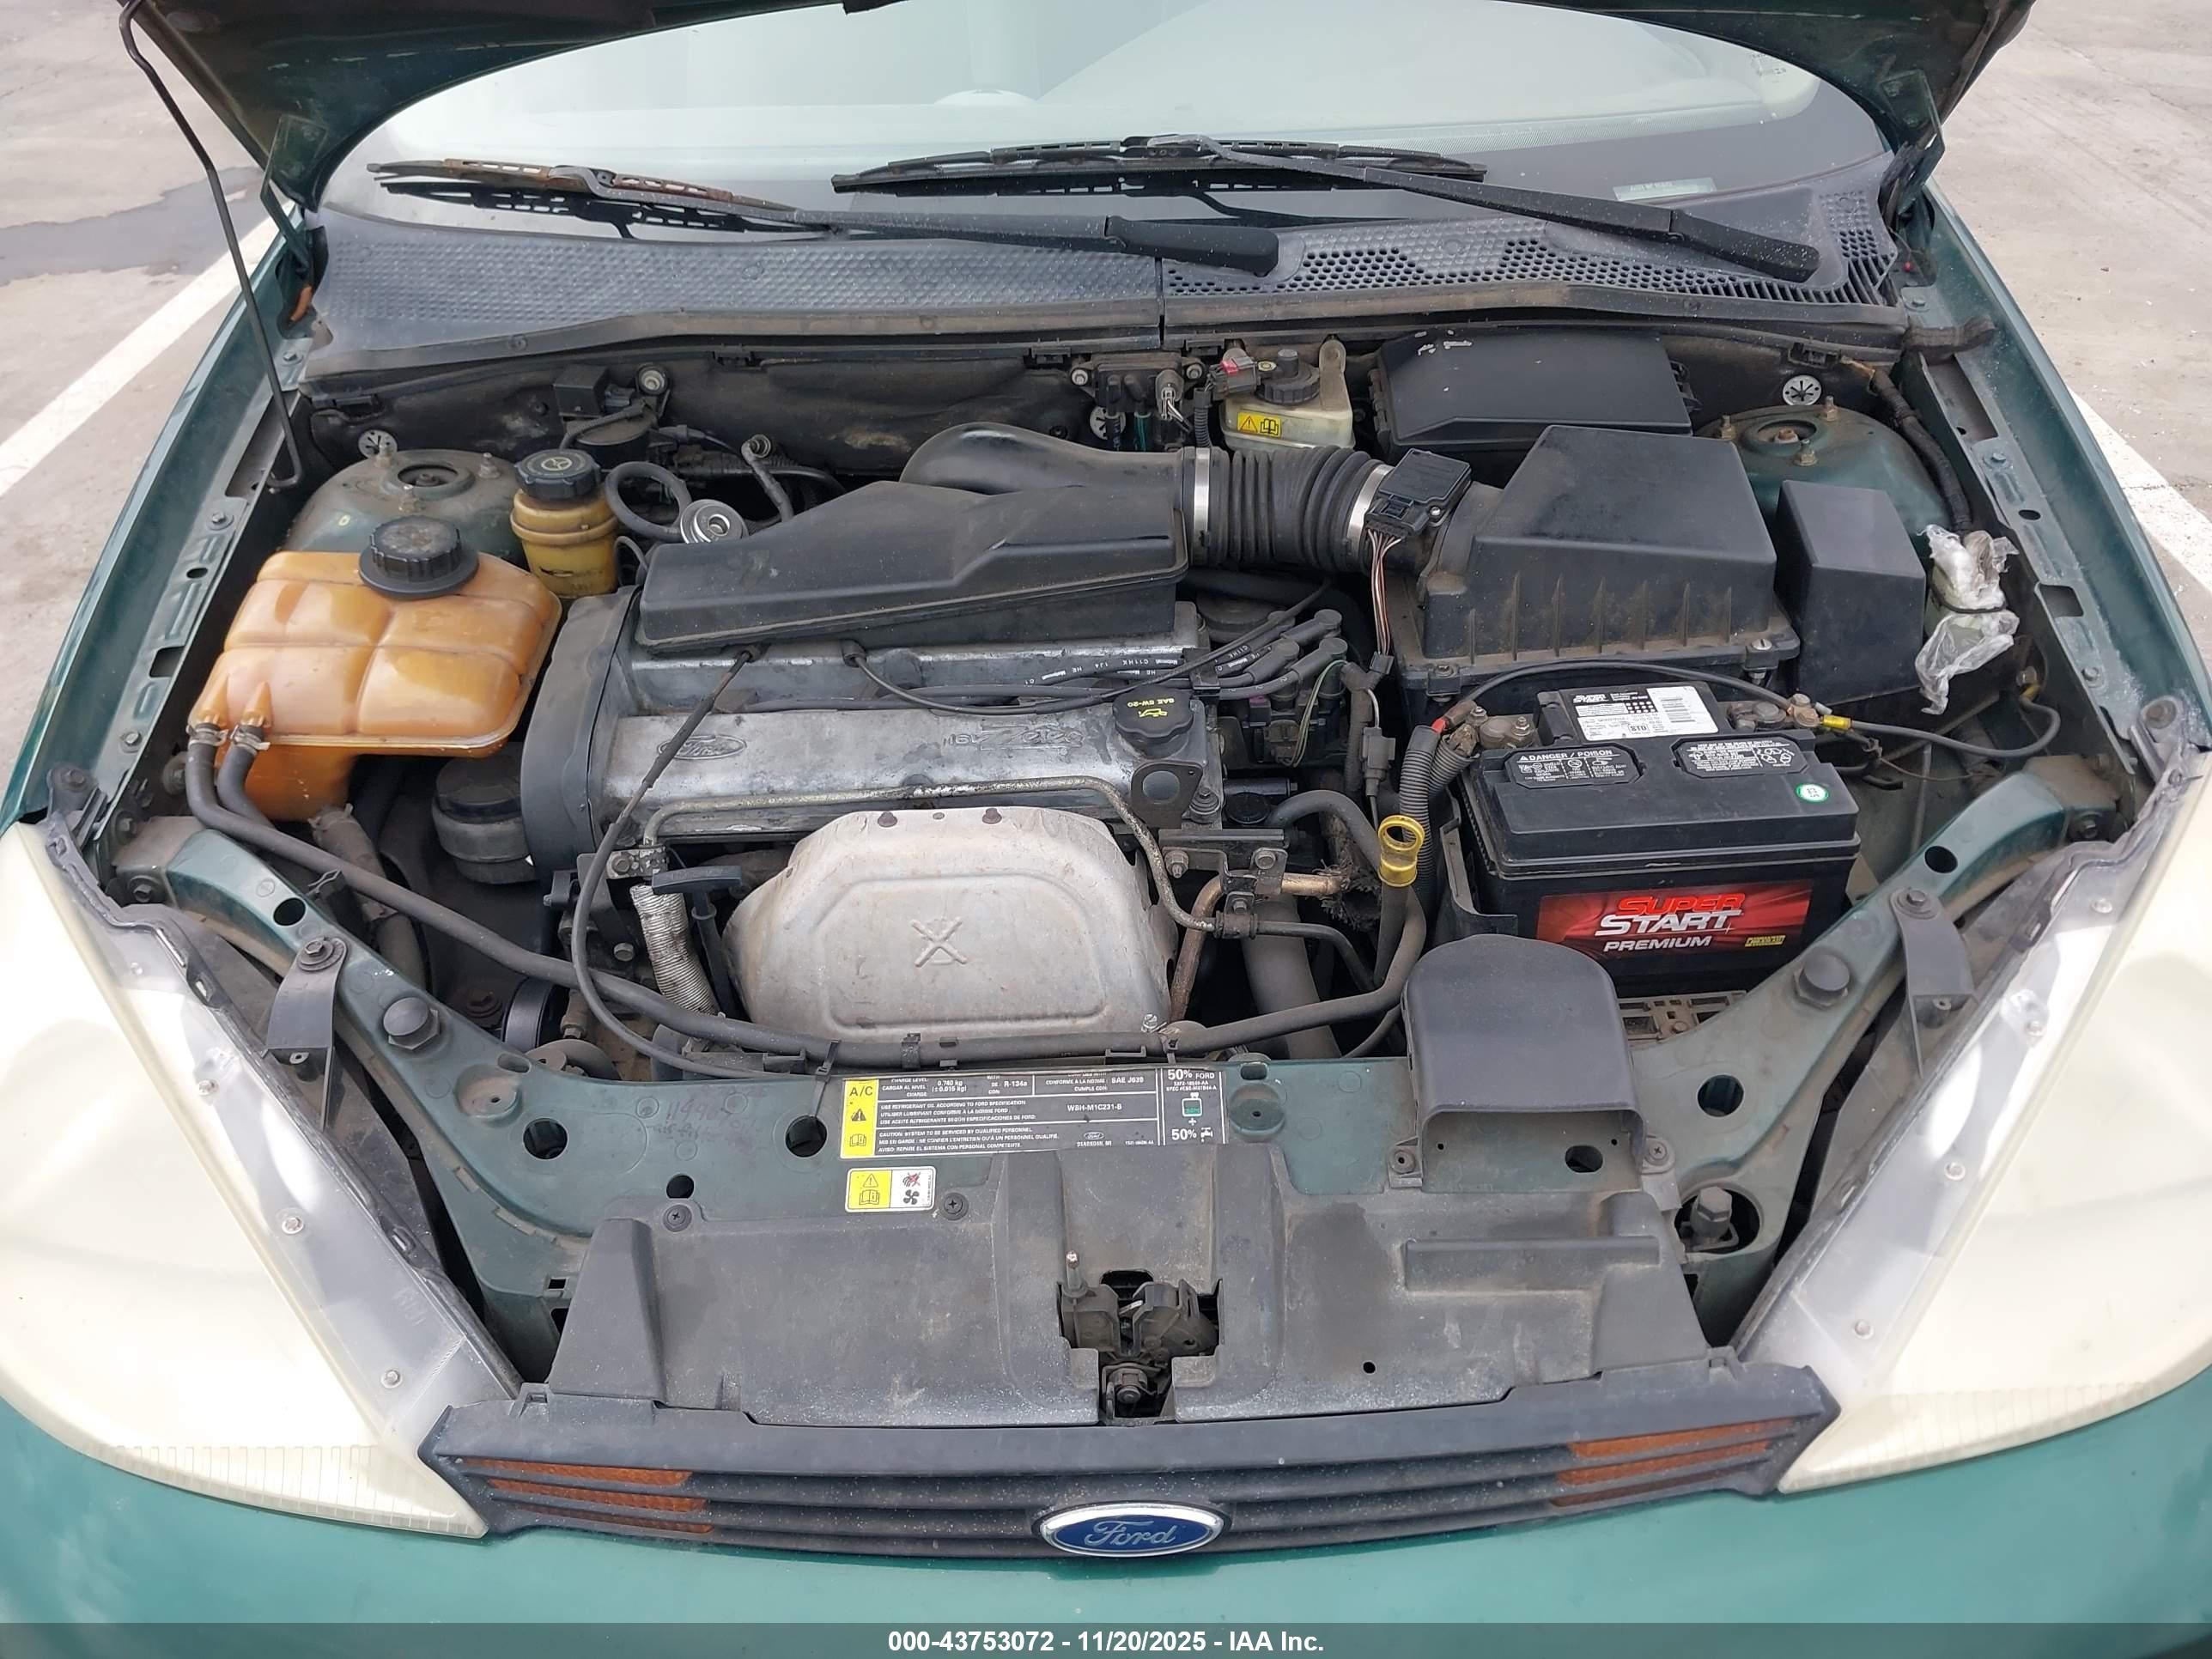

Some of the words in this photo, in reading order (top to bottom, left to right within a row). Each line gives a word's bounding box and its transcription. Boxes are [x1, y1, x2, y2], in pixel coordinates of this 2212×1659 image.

[1528, 752, 1568, 761] DANGER
[1619, 893, 1746, 916] SUPER
[1595, 909, 1744, 937] START
[1603, 935, 1713, 952] PREMIUM
[1168, 1068, 1193, 1080] 50%
[849, 1085, 873, 1097] A/C
[1171, 1127, 1197, 1141] 50%
[1085, 1521, 1178, 1547] Ford
